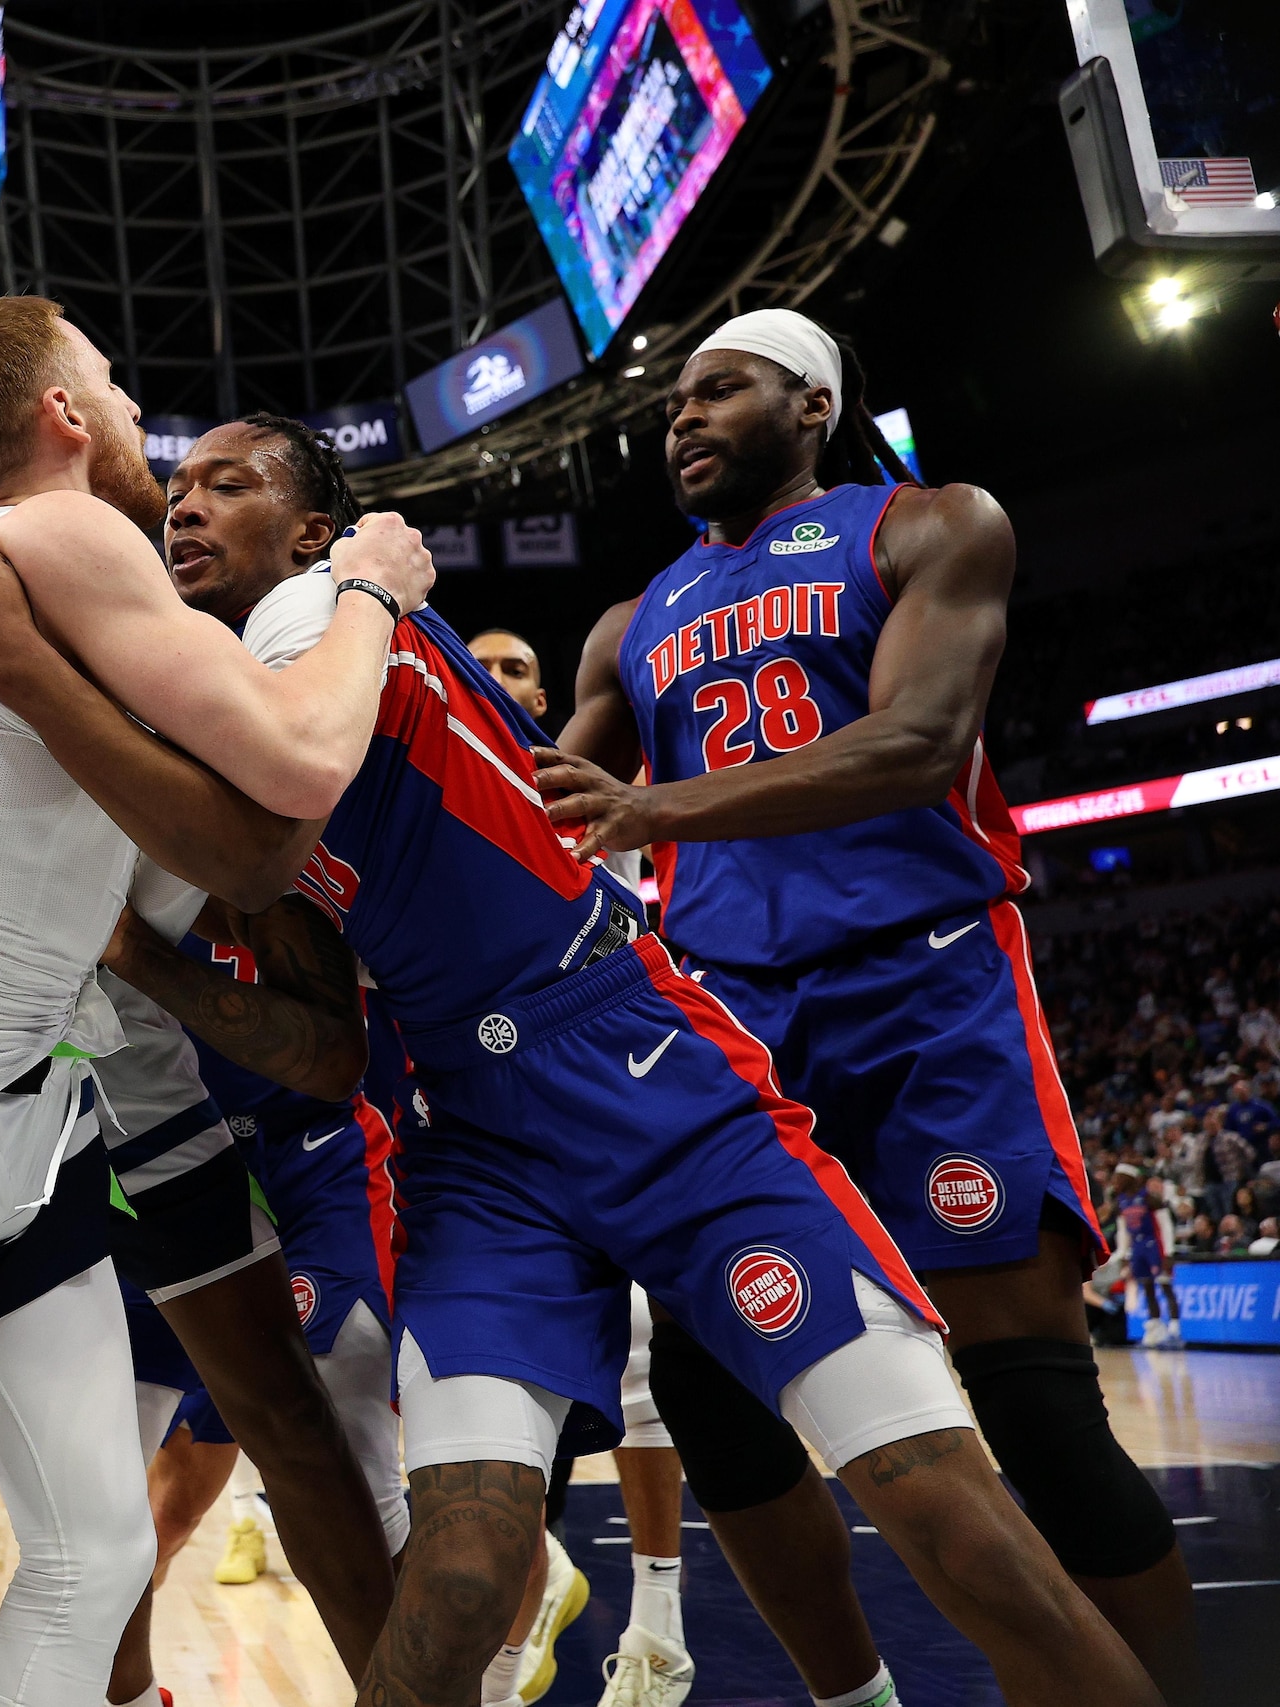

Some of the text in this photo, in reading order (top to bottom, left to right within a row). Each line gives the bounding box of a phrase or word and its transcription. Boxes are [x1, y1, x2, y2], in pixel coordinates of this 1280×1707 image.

[773, 538, 837, 553] StockX
[353, 579, 392, 605] Blessed
[646, 582, 845, 699] DETROIT
[1125, 690, 1172, 708] TCL
[693, 657, 822, 773] 28
[1216, 768, 1278, 789] TCL
[558, 934, 584, 971] DETROIT
[936, 1178, 984, 1194] DETROIT
[938, 1191, 988, 1207] PISTONS
[737, 1265, 783, 1304] DETROIT
[745, 1278, 793, 1317] PISTONS
[1173, 1284, 1259, 1320] ESSIVE
